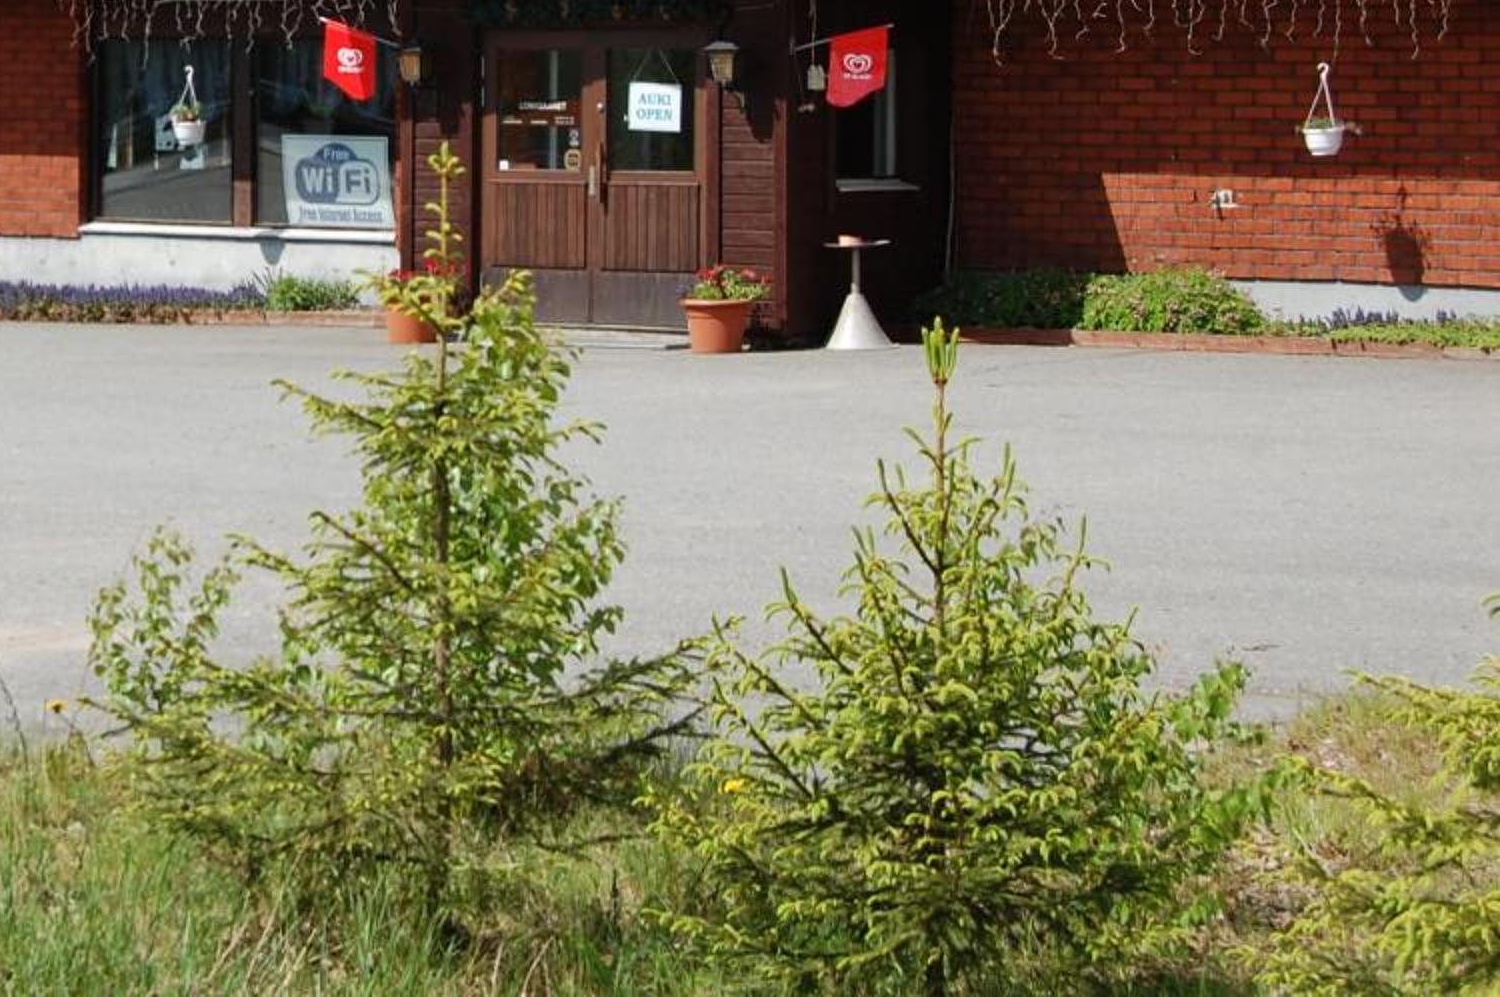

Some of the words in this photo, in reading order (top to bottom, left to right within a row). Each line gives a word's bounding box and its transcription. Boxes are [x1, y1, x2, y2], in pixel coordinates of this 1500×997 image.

[637, 93, 671, 105] AUKI
[636, 108, 672, 121] OPEN
[323, 147, 350, 162] Free
